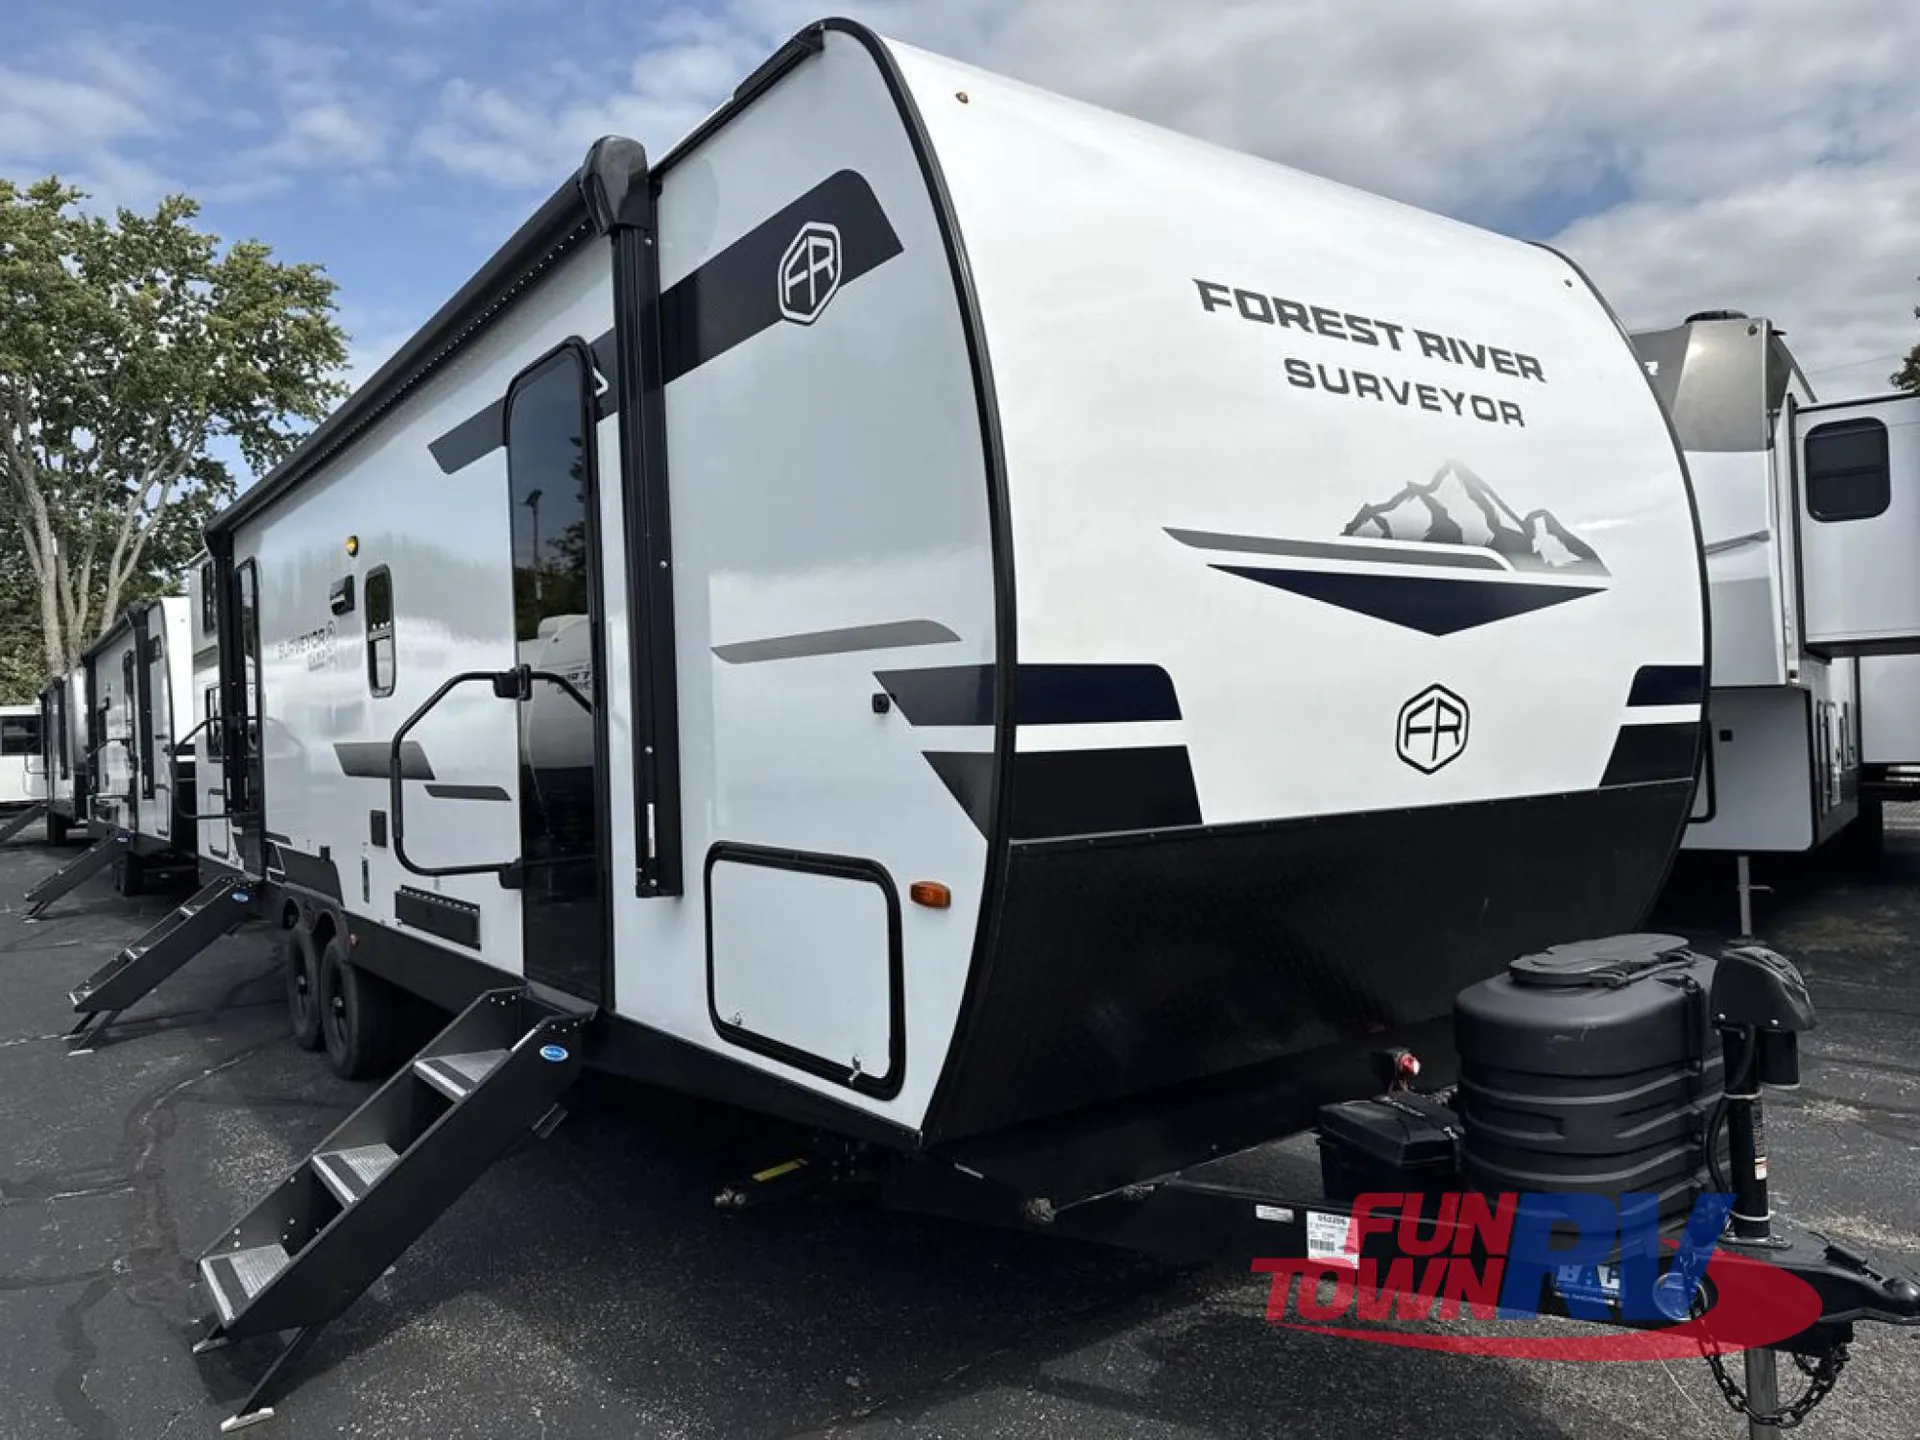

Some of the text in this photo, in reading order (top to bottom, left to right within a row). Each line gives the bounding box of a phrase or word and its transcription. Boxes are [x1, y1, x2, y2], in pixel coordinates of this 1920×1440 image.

[1192, 278, 1547, 383] FOREST RIVER
[1284, 358, 1525, 428] SURVEYOR
